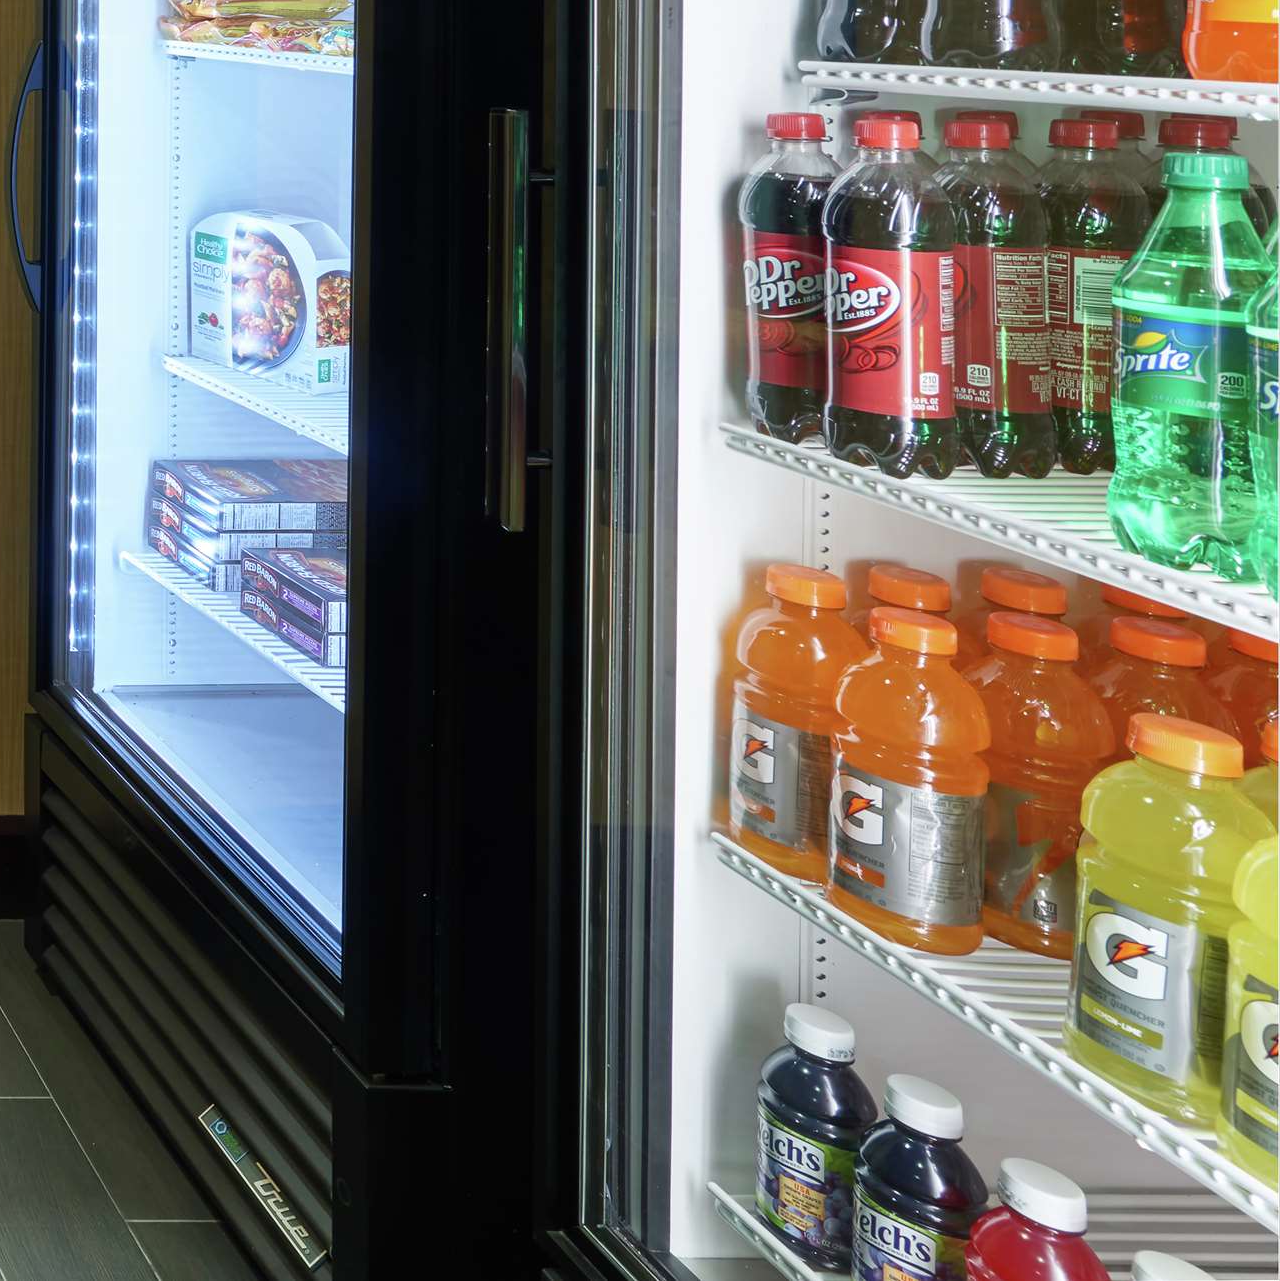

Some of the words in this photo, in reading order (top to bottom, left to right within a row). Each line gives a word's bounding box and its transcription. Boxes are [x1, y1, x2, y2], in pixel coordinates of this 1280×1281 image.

[196, 244, 225, 258] Choice
[996, 254, 1027, 262] Nutrition
[759, 256, 801, 283] Dr
[844, 308, 877, 320] Est.1885
[1113, 342, 1191, 378] Sprite
[969, 367, 988, 377] 210
[922, 374, 937, 385] 210
[1220, 375, 1245, 387] 200
[975, 395, 991, 404] mL)
[979, 389, 991, 397] OZ
[1056, 387, 1080, 400] VT-CT
[244, 558, 257, 573] RED
[256, 564, 279, 592] BARON
[282, 588, 289, 599] 2
[244, 593, 256, 606] RED
[256, 597, 278, 625] BARON
[282, 622, 289, 633] 2
[733, 719, 776, 785] G
[829, 773, 885, 846] G
[1085, 911, 1169, 1001] G
[1110, 997, 1166, 1028] QUENCHER
[1093, 1007, 1143, 1038] LEMON-LIME
[793, 1181, 811, 1196] USA
